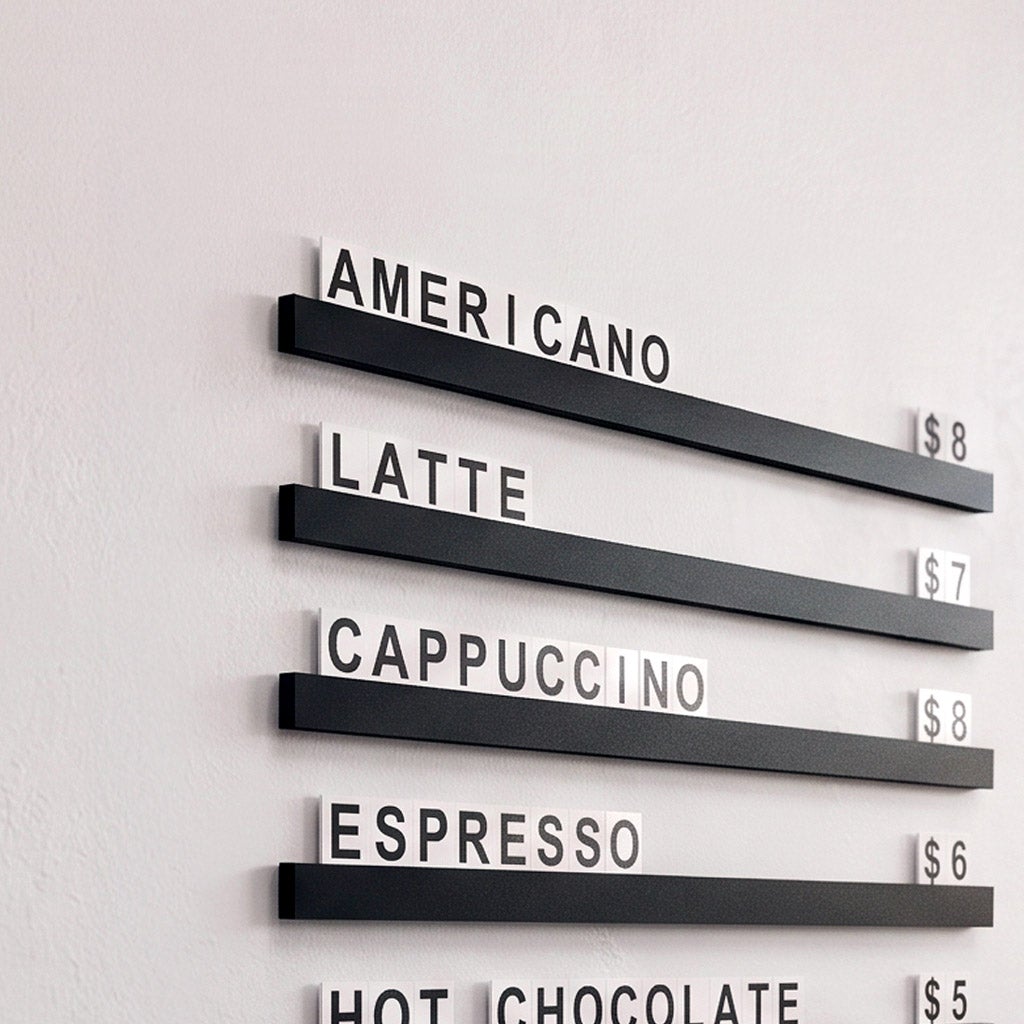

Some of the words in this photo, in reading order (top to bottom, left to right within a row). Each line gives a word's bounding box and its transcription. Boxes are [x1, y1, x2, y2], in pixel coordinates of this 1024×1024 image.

[327, 248, 669, 384] AMERICANO
[924, 412, 966, 461] $8
[332, 433, 526, 522] LATTE
[924, 552, 965, 601] $7
[328, 617, 705, 713] CAPPUCCINO
[924, 694, 967, 743] $8
[330, 803, 640, 870] ESPRESSO
[924, 836, 966, 884] $6
